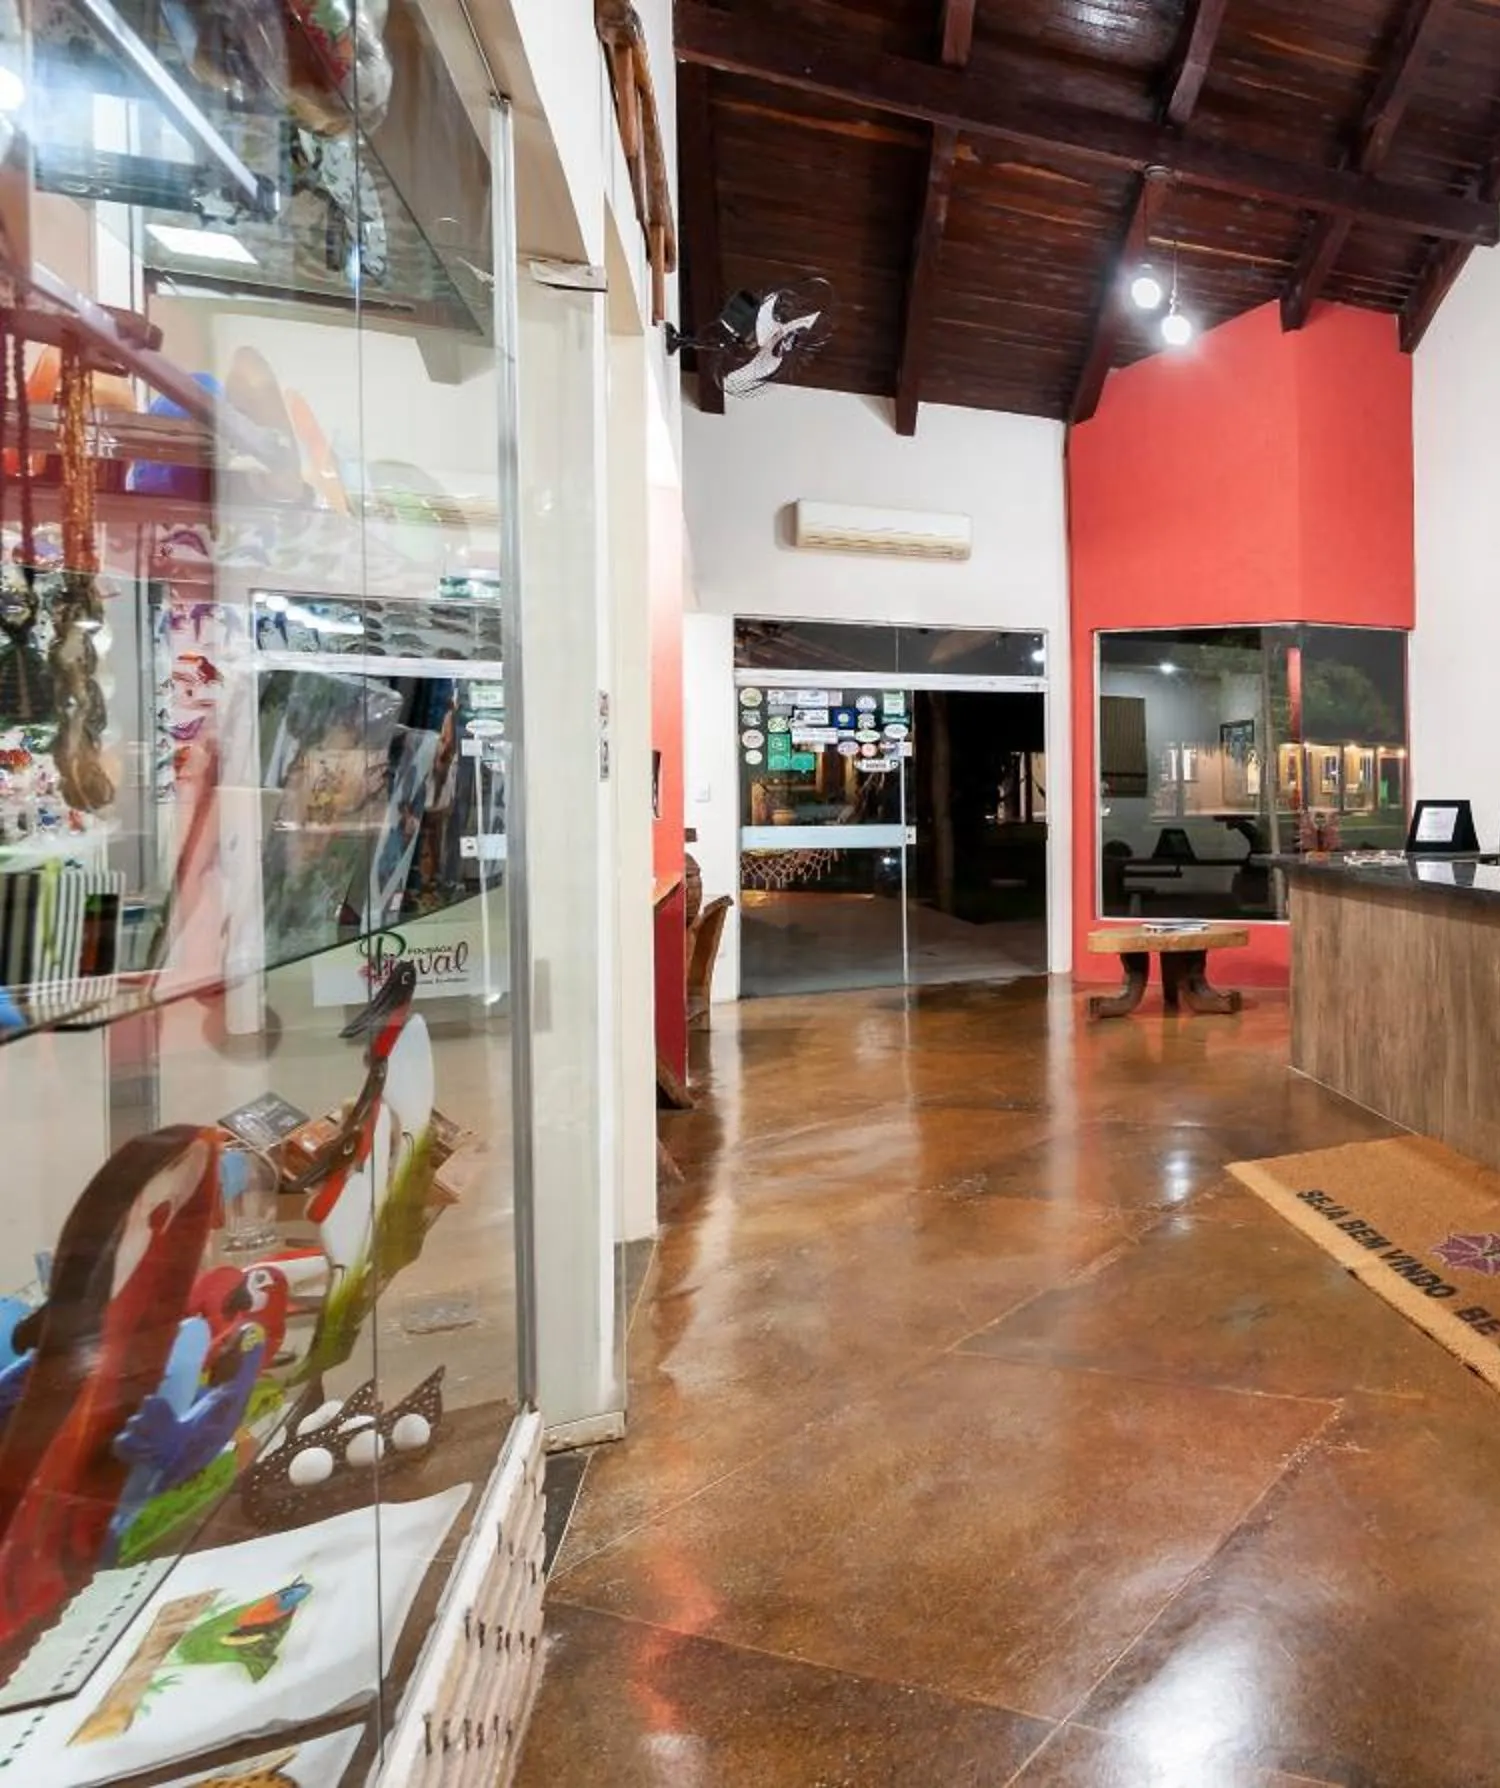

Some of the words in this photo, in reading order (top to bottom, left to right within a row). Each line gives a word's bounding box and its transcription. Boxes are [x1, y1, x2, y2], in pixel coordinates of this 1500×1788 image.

[1296, 1189, 1350, 1221] SEJA
[1336, 1219, 1393, 1250] BEM
[1378, 1248, 1458, 1299] VINDO
